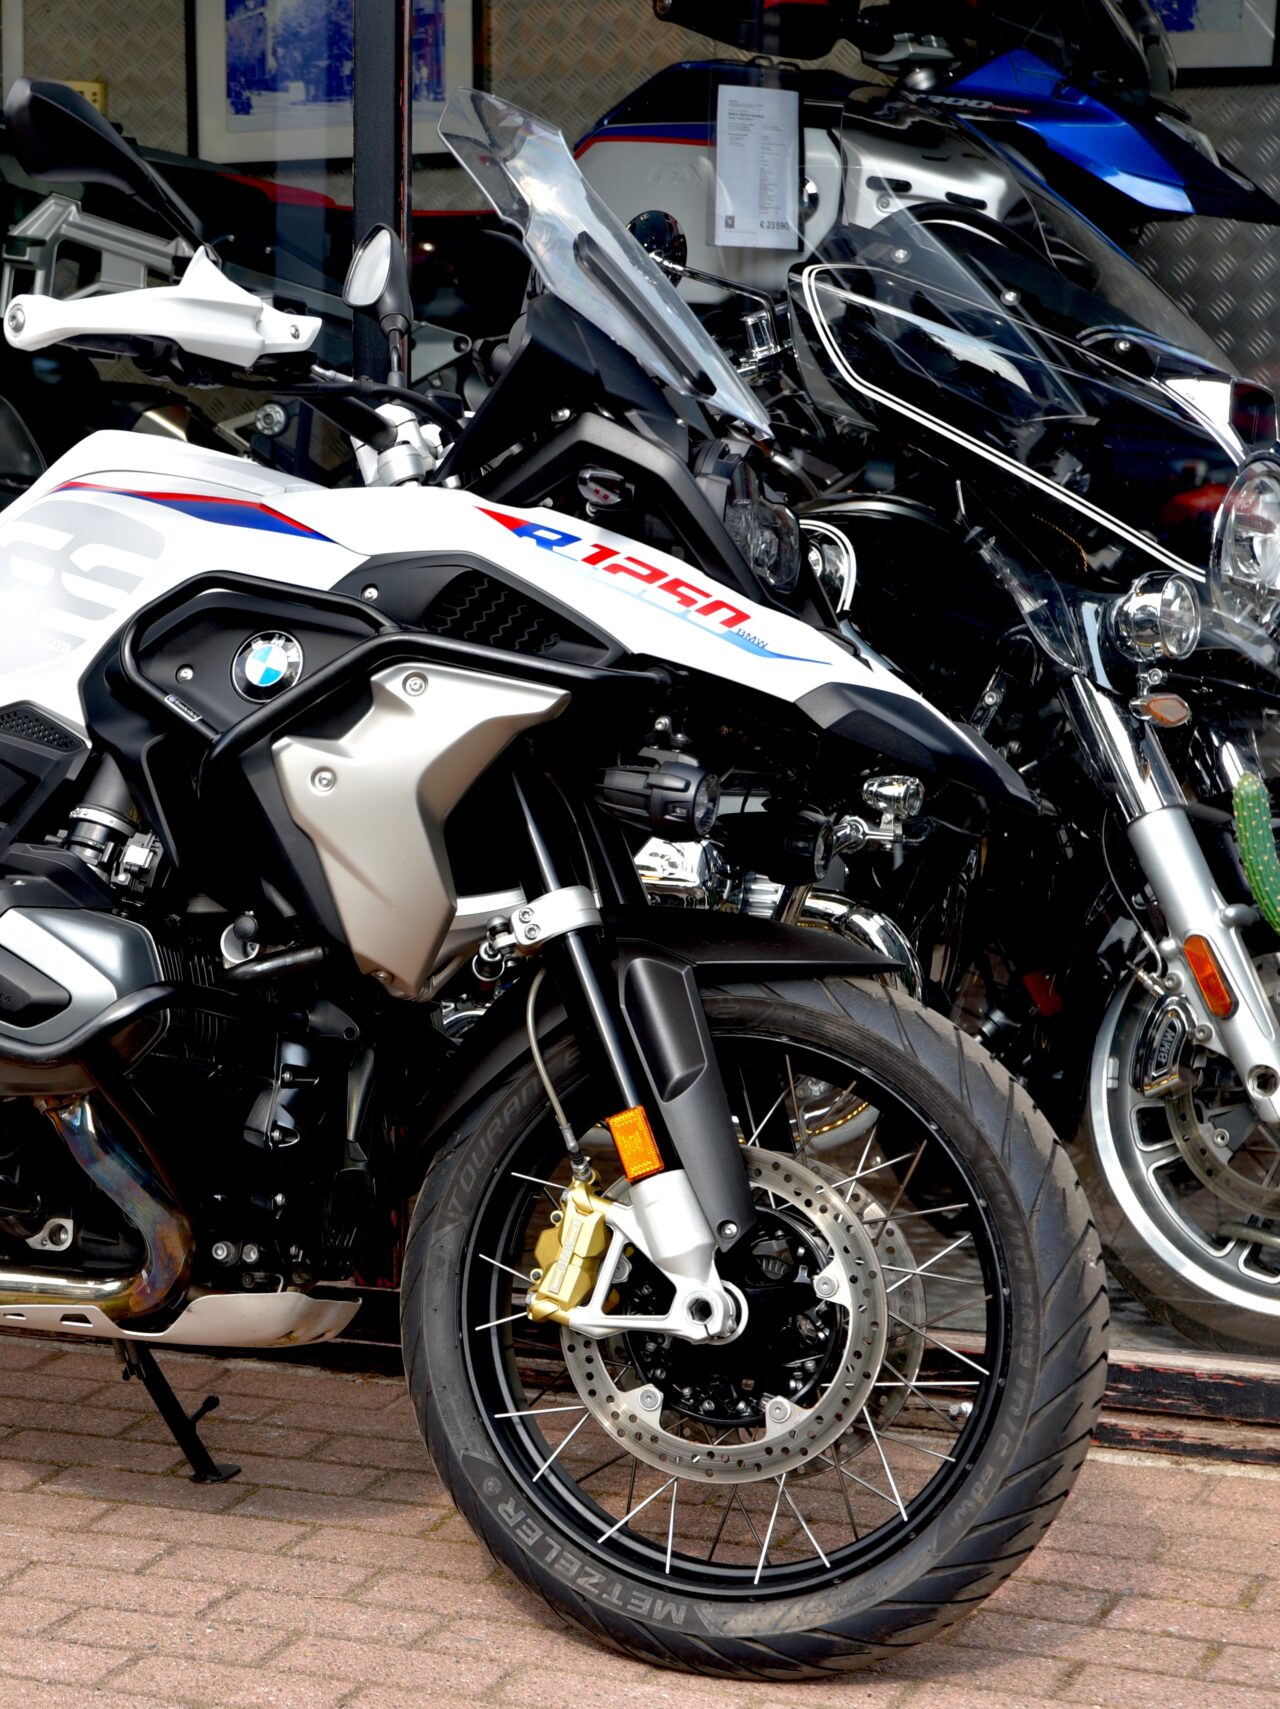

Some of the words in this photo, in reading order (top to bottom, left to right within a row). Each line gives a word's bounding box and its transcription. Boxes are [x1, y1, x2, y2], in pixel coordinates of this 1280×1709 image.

[511, 522, 582, 551] R
[581, 543, 751, 629] 1250
[251, 633, 300, 662] BMW
[736, 627, 769, 650] BMW
[1157, 1027, 1177, 1064] BMW
[497, 1497, 688, 1626] METZELER
